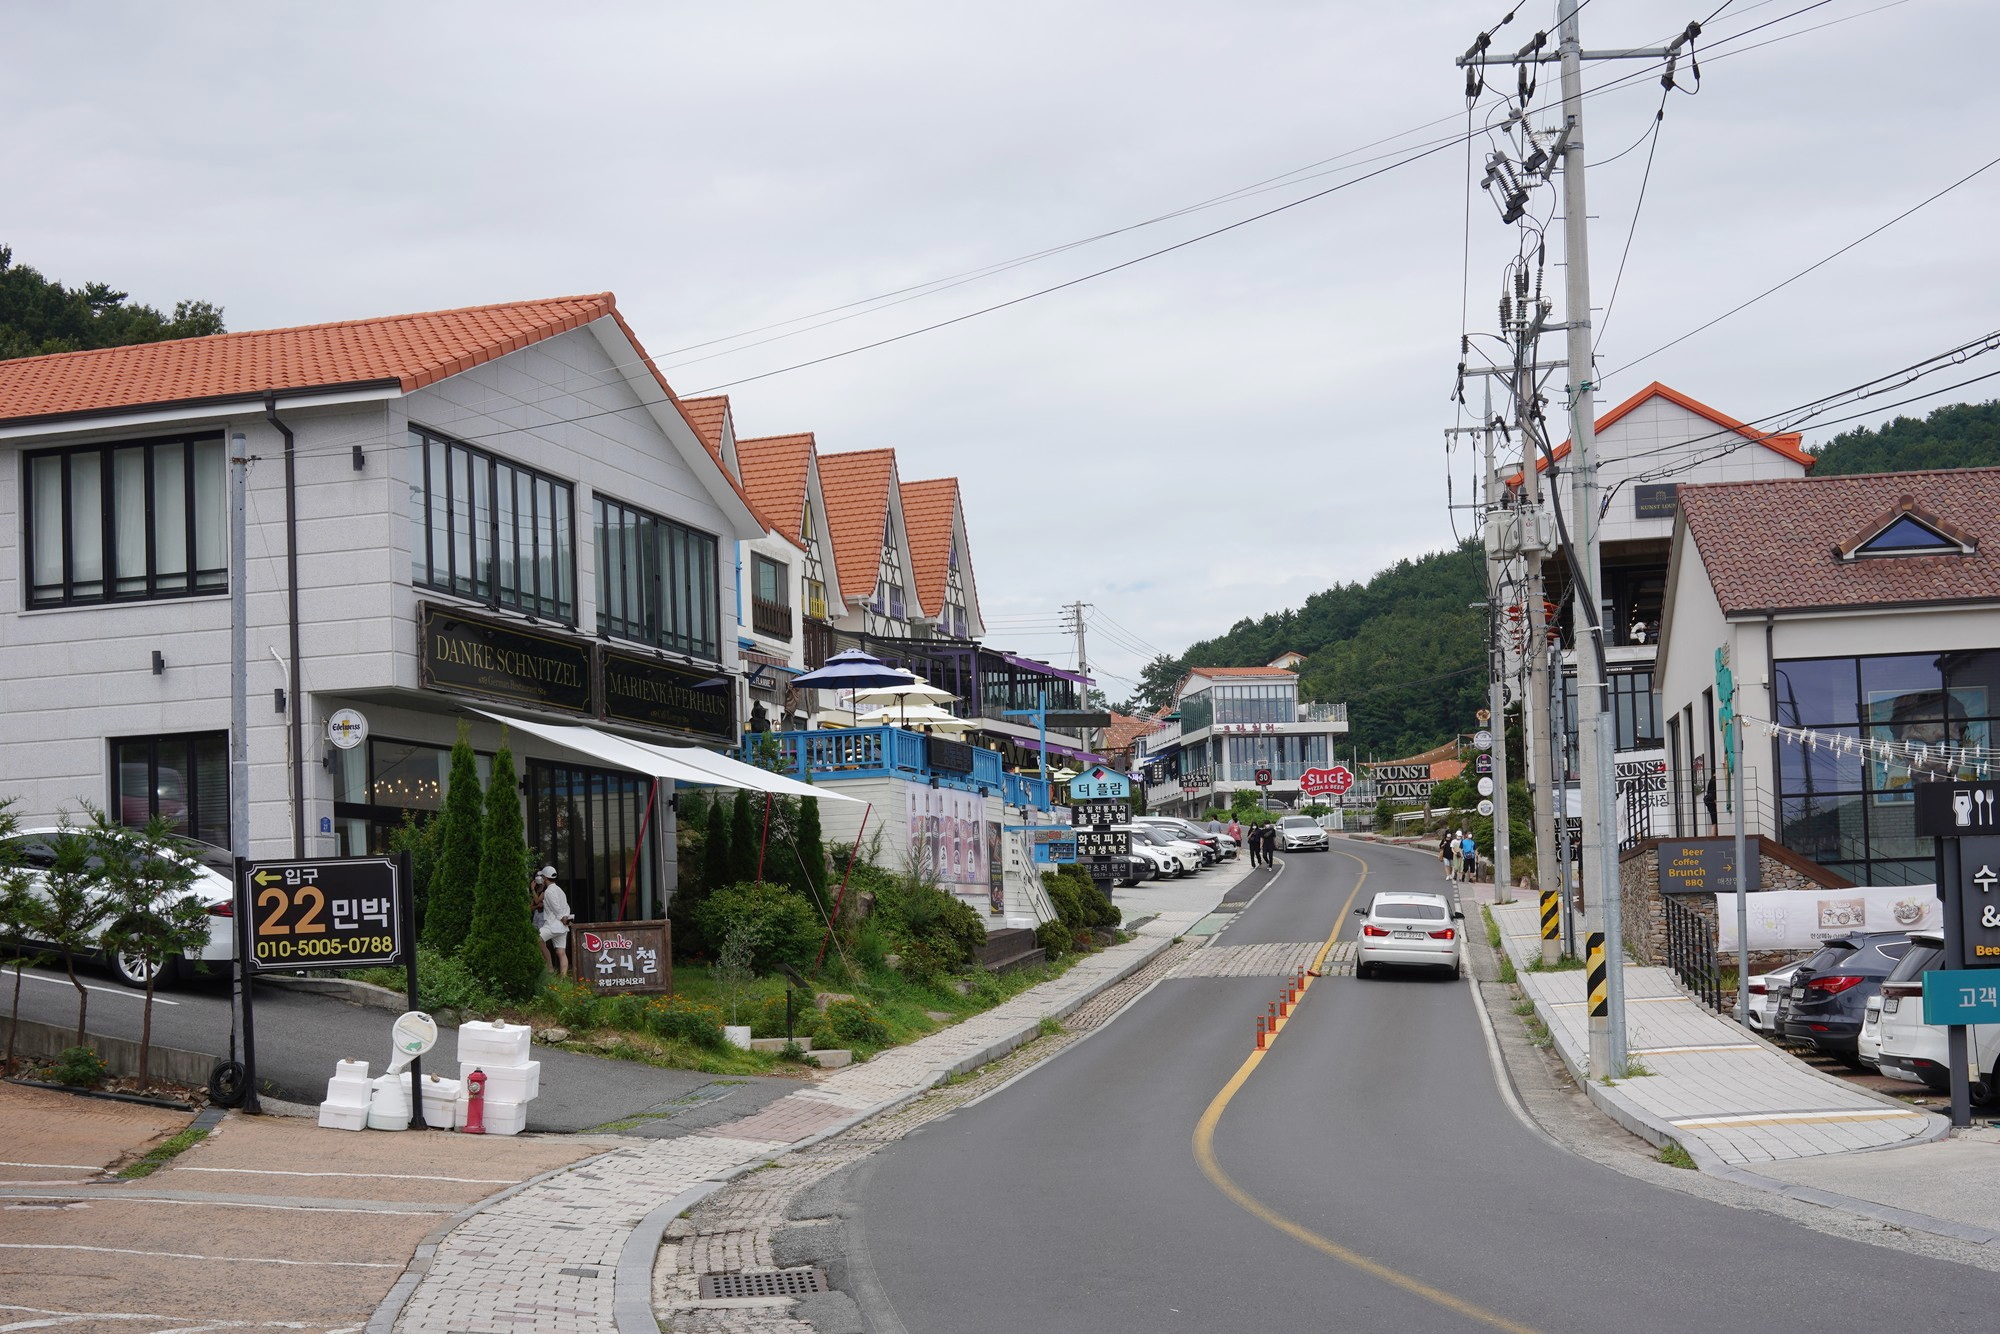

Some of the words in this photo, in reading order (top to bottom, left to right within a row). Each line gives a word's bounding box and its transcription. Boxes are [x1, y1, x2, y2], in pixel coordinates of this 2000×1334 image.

[436, 634, 494, 671] DANKE
[497, 648, 581, 688] SCHNITZEL
[610, 672, 726, 716] MARIENKÄFERHAUS
[1308, 772, 1344, 786] SLICE
[1375, 764, 1429, 780] KUNST
[1079, 783, 1090, 797] 더
[1097, 782, 1122, 796] 플람
[1078, 833, 1127, 845] 화덕피자
[1682, 848, 1704, 857] Beer
[1673, 858, 1699, 866] Coffee
[285, 868, 318, 885] 입구
[1668, 867, 1706, 877] Brunch
[257, 886, 326, 935] 22
[332, 897, 391, 930] 민박
[257, 935, 393, 959] 010-5005-0788
[595, 946, 657, 974] 슈니첼
[598, 977, 646, 987] 유럽가정식요리
[1959, 987, 1998, 1008] 고객
